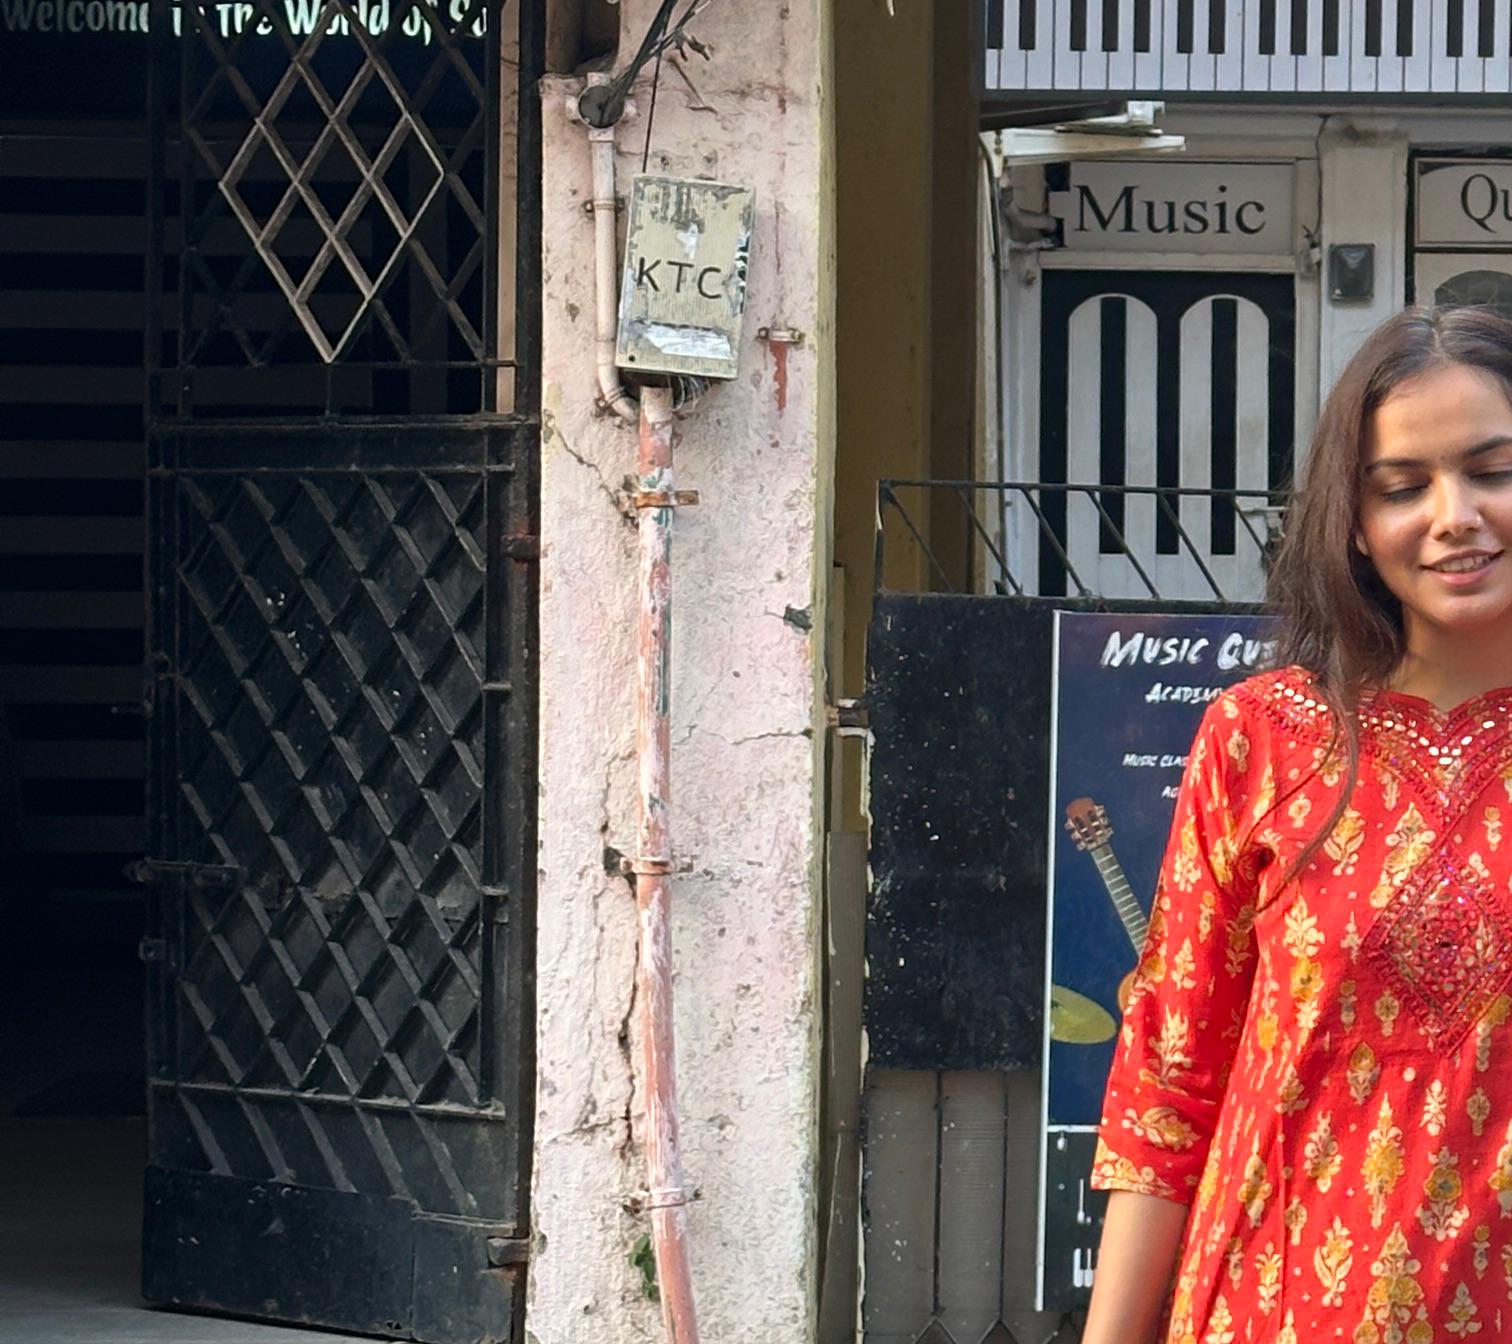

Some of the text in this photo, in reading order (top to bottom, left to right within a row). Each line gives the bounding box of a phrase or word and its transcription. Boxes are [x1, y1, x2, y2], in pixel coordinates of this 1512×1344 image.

[1073, 184, 1267, 235] Music
[636, 256, 722, 300] KTC
[1101, 631, 1210, 668] MUSIC
